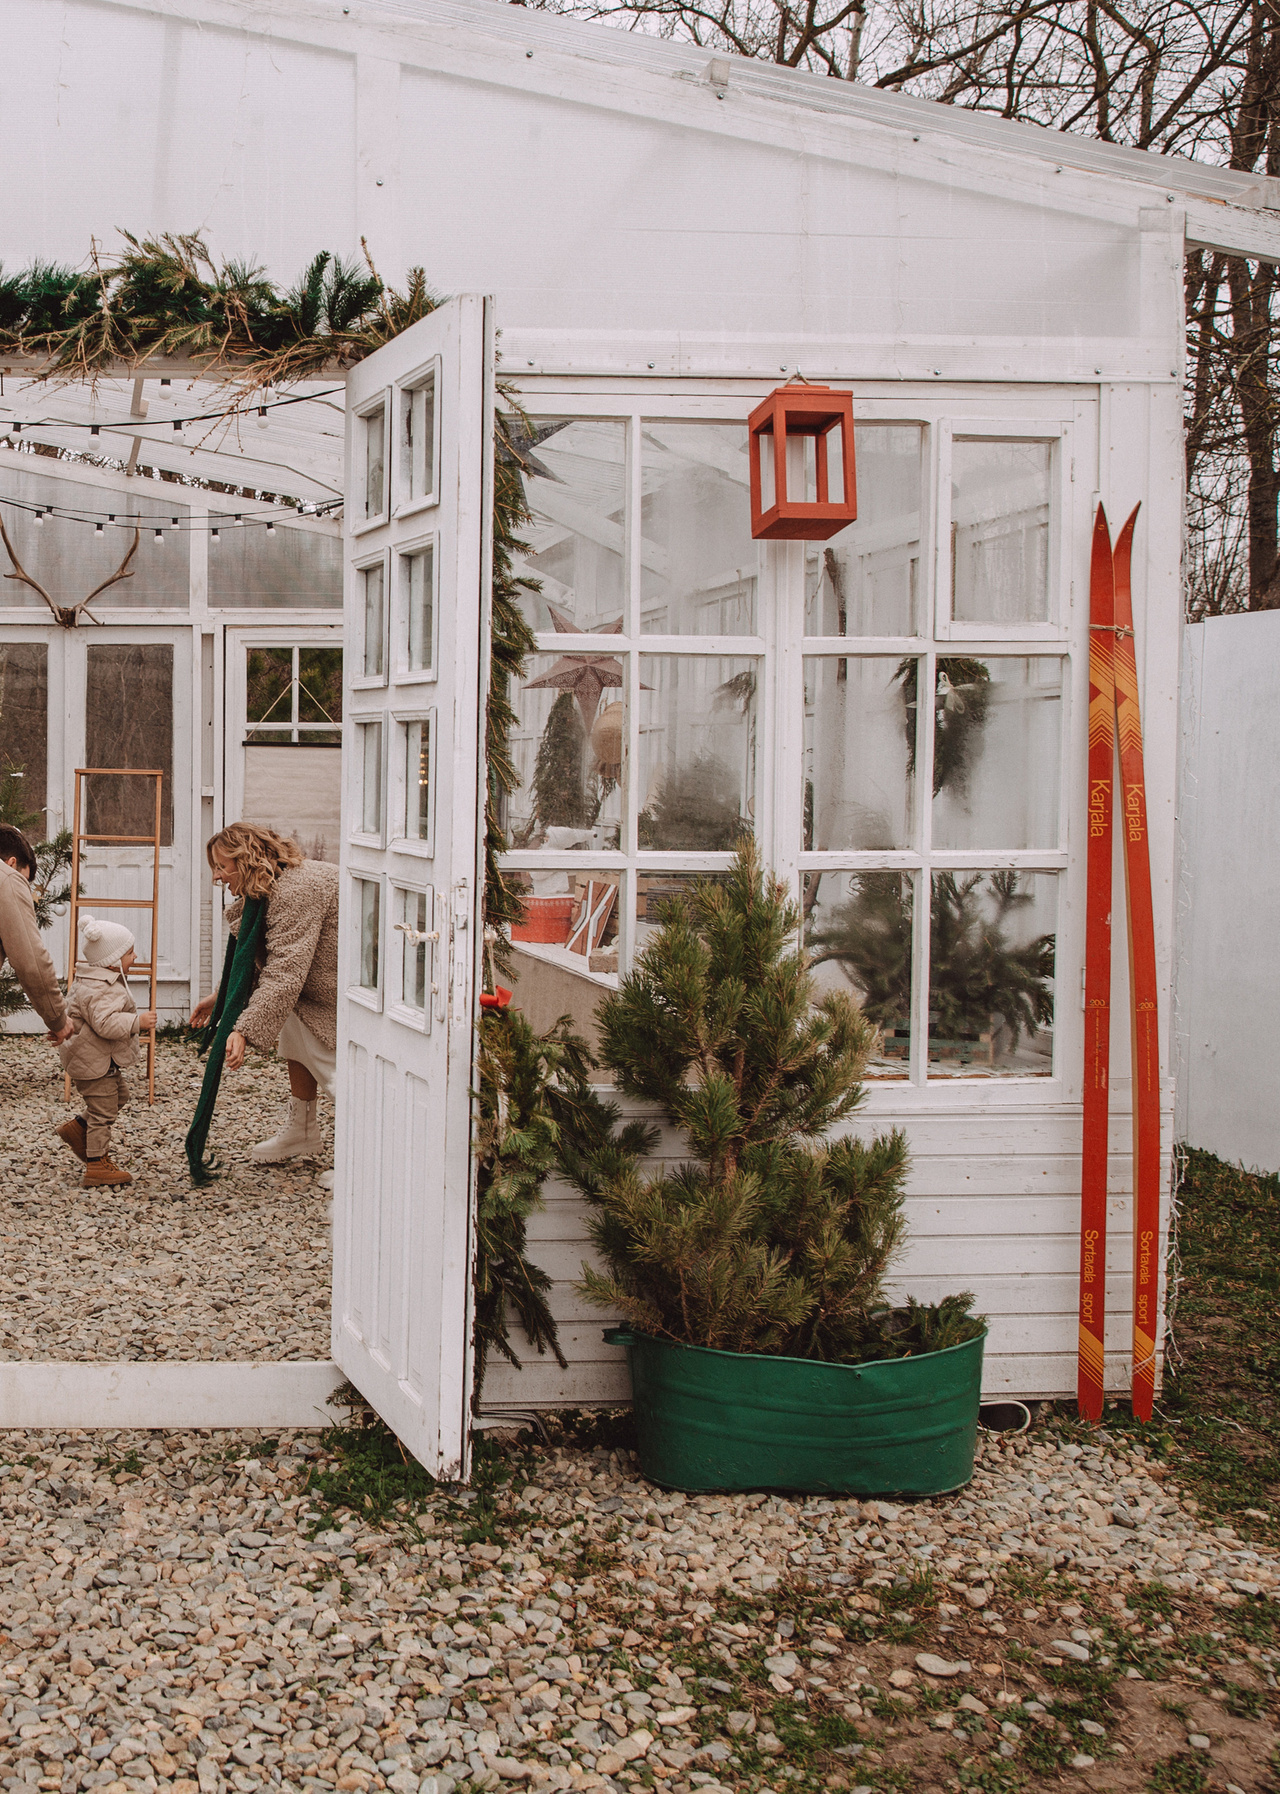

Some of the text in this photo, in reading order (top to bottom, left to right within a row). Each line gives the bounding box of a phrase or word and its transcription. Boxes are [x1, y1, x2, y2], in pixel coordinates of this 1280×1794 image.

[1089, 780, 1110, 837] Karjala
[1125, 784, 1145, 842] Karjala
[1081, 1229, 1099, 1324] Sortavala sport
[1137, 1231, 1153, 1325] Sortavala sport
